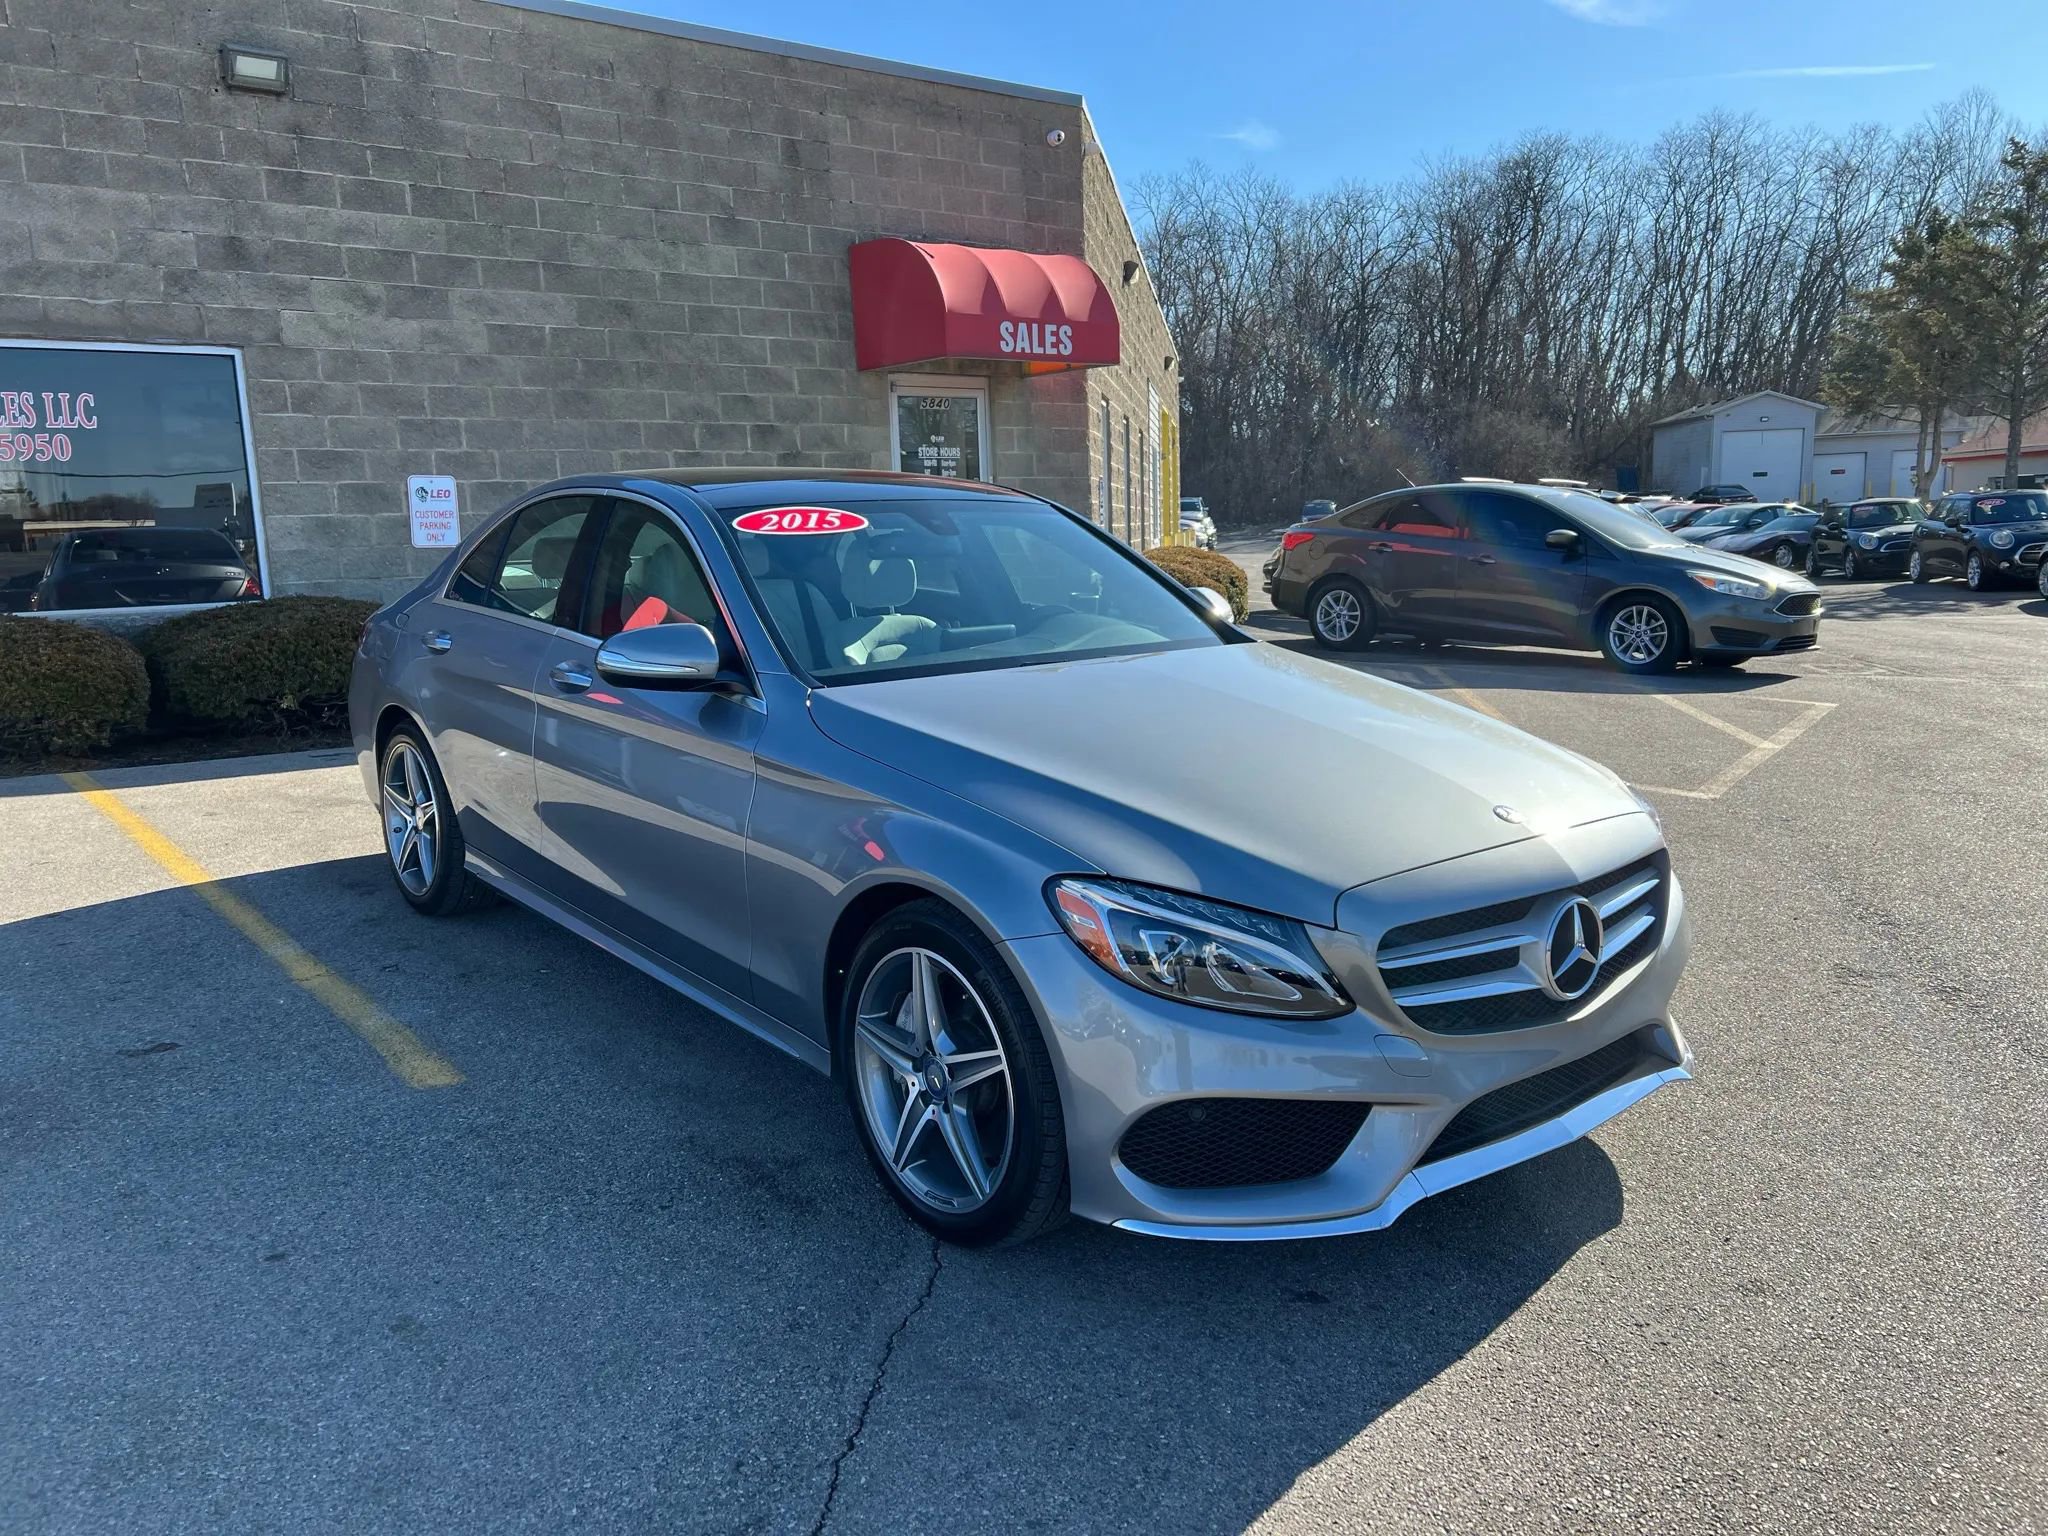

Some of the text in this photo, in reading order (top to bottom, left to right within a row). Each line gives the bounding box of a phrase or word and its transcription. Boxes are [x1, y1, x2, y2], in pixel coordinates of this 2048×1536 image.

[1000, 320, 1073, 356] SALES
[921, 398, 950, 409] 5840
[41, 392, 98, 429] LLC
[0, 433, 72, 462] 5950
[918, 447, 961, 457] STORE HOURS
[430, 489, 451, 498] LEO
[414, 510, 454, 519] CUSTOMER
[419, 521, 452, 530] PARKING
[759, 512, 842, 531] 2015
[426, 533, 446, 542] ONLY
